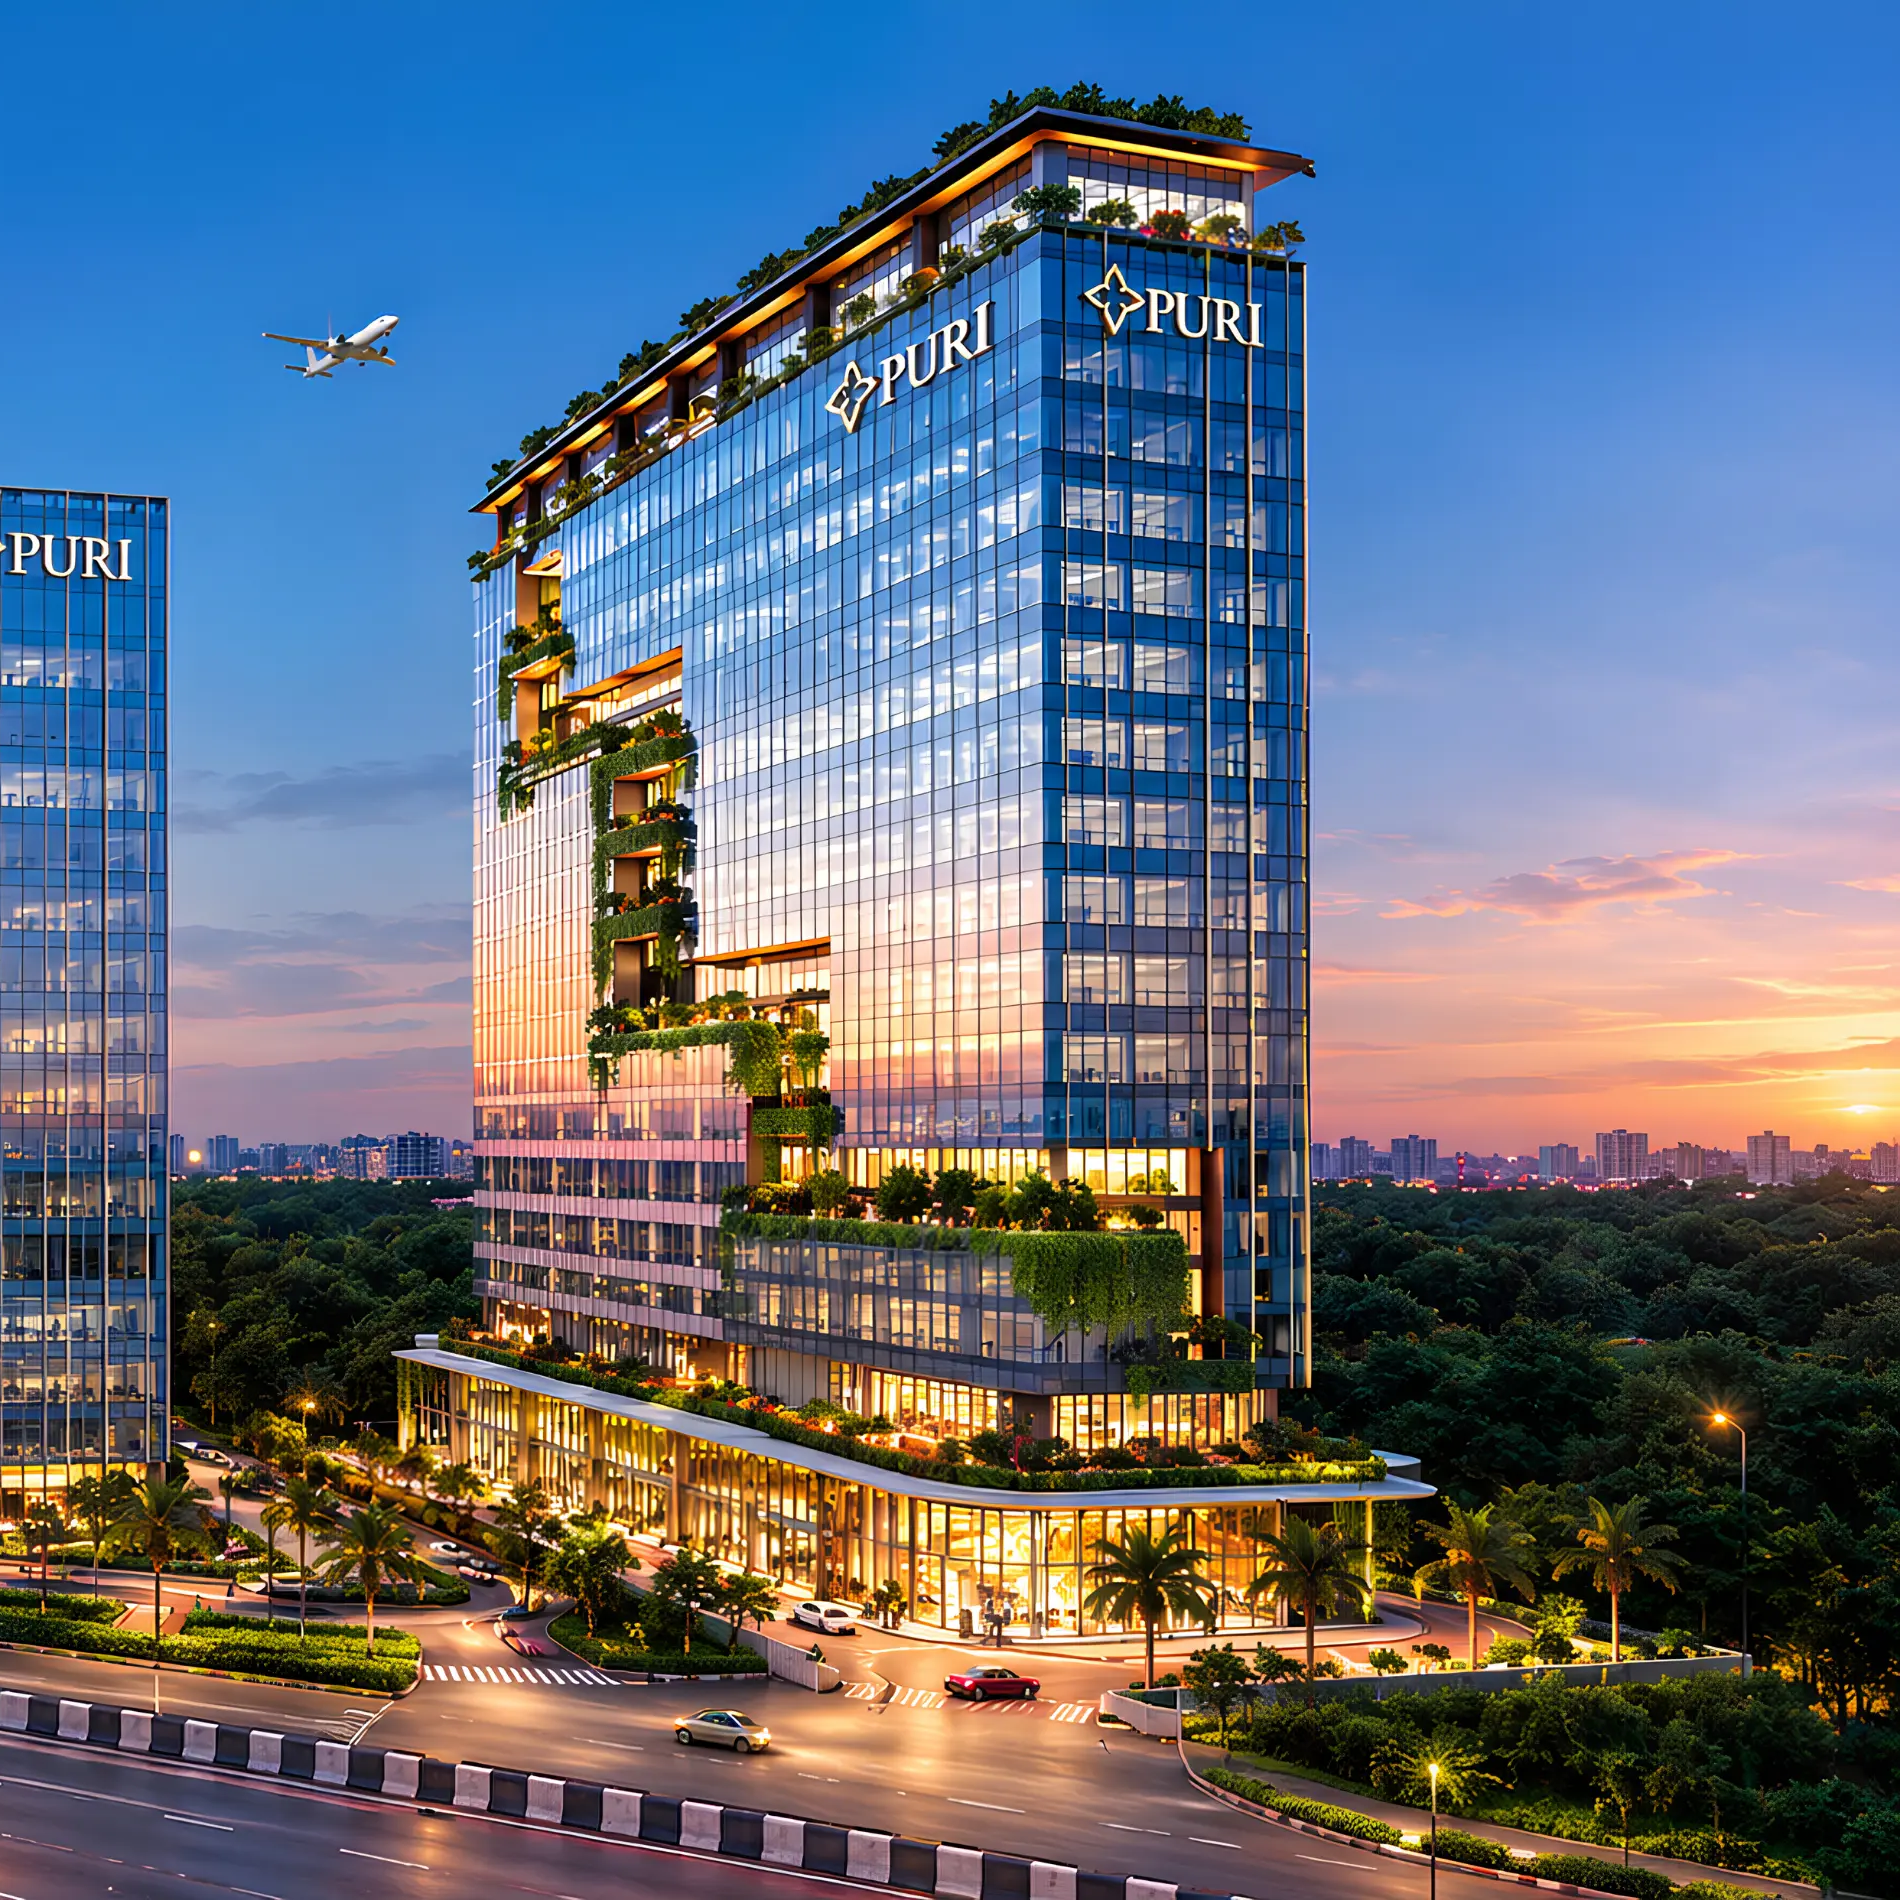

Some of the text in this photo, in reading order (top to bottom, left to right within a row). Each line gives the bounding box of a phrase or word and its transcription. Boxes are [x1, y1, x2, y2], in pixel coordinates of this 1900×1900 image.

[1145, 287, 1265, 348] PURI
[879, 299, 994, 408] PURI
[5, 532, 133, 581] PURI
